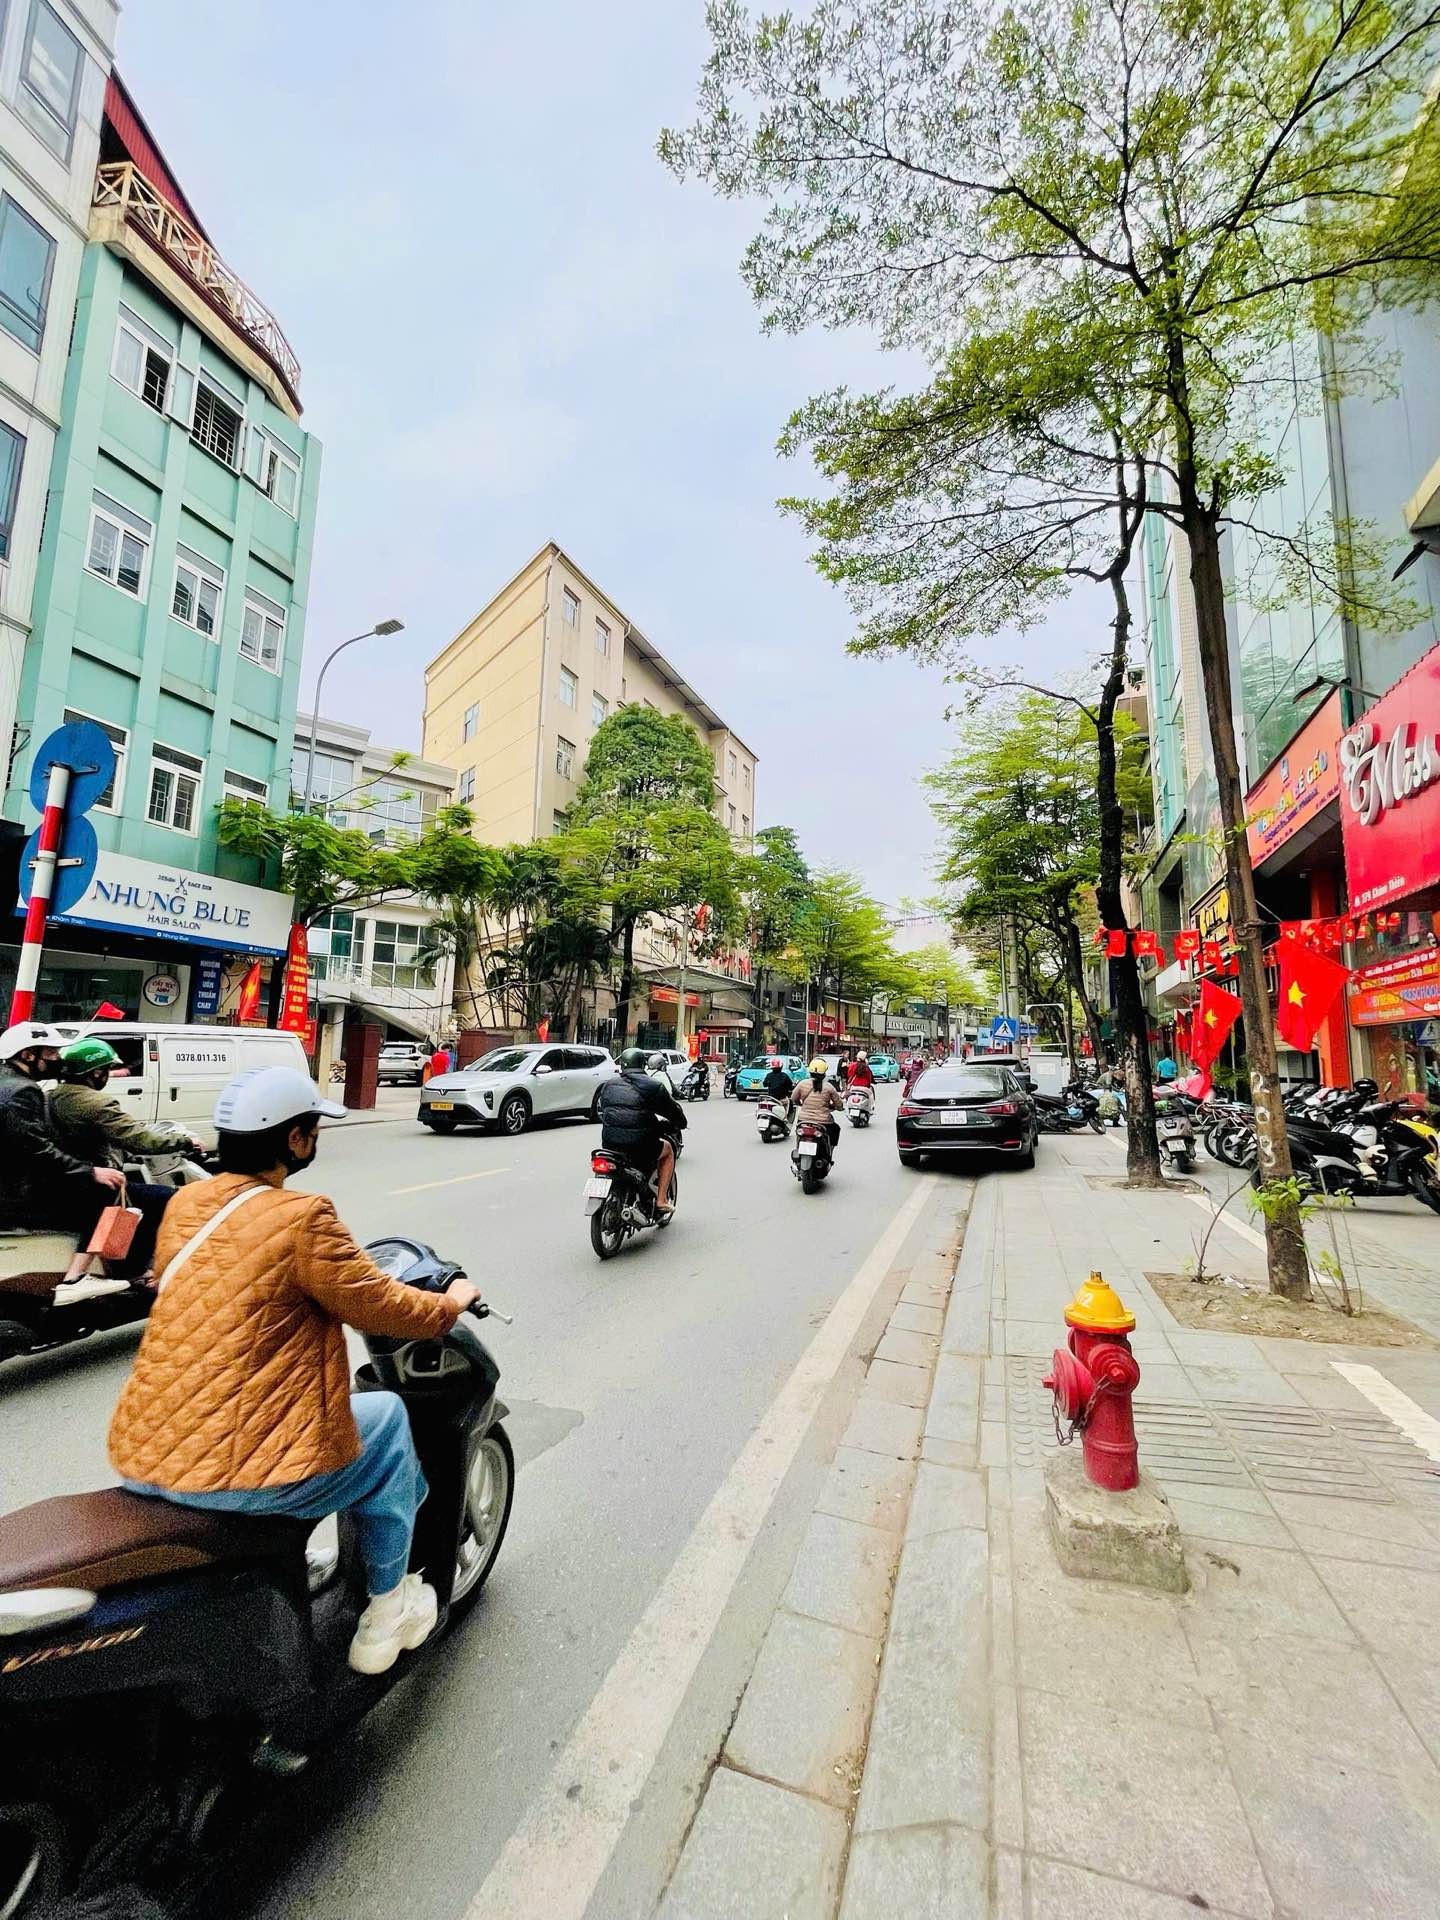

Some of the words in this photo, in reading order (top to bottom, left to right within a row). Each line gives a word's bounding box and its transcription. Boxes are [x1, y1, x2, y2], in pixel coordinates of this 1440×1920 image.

[91, 880, 185, 915] NHUNG
[194, 901, 251, 927] BLUE
[147, 914, 169, 926] HAIR
[172, 919, 201, 930] SALON
[176, 1053, 226, 1062] 0378.011.316
